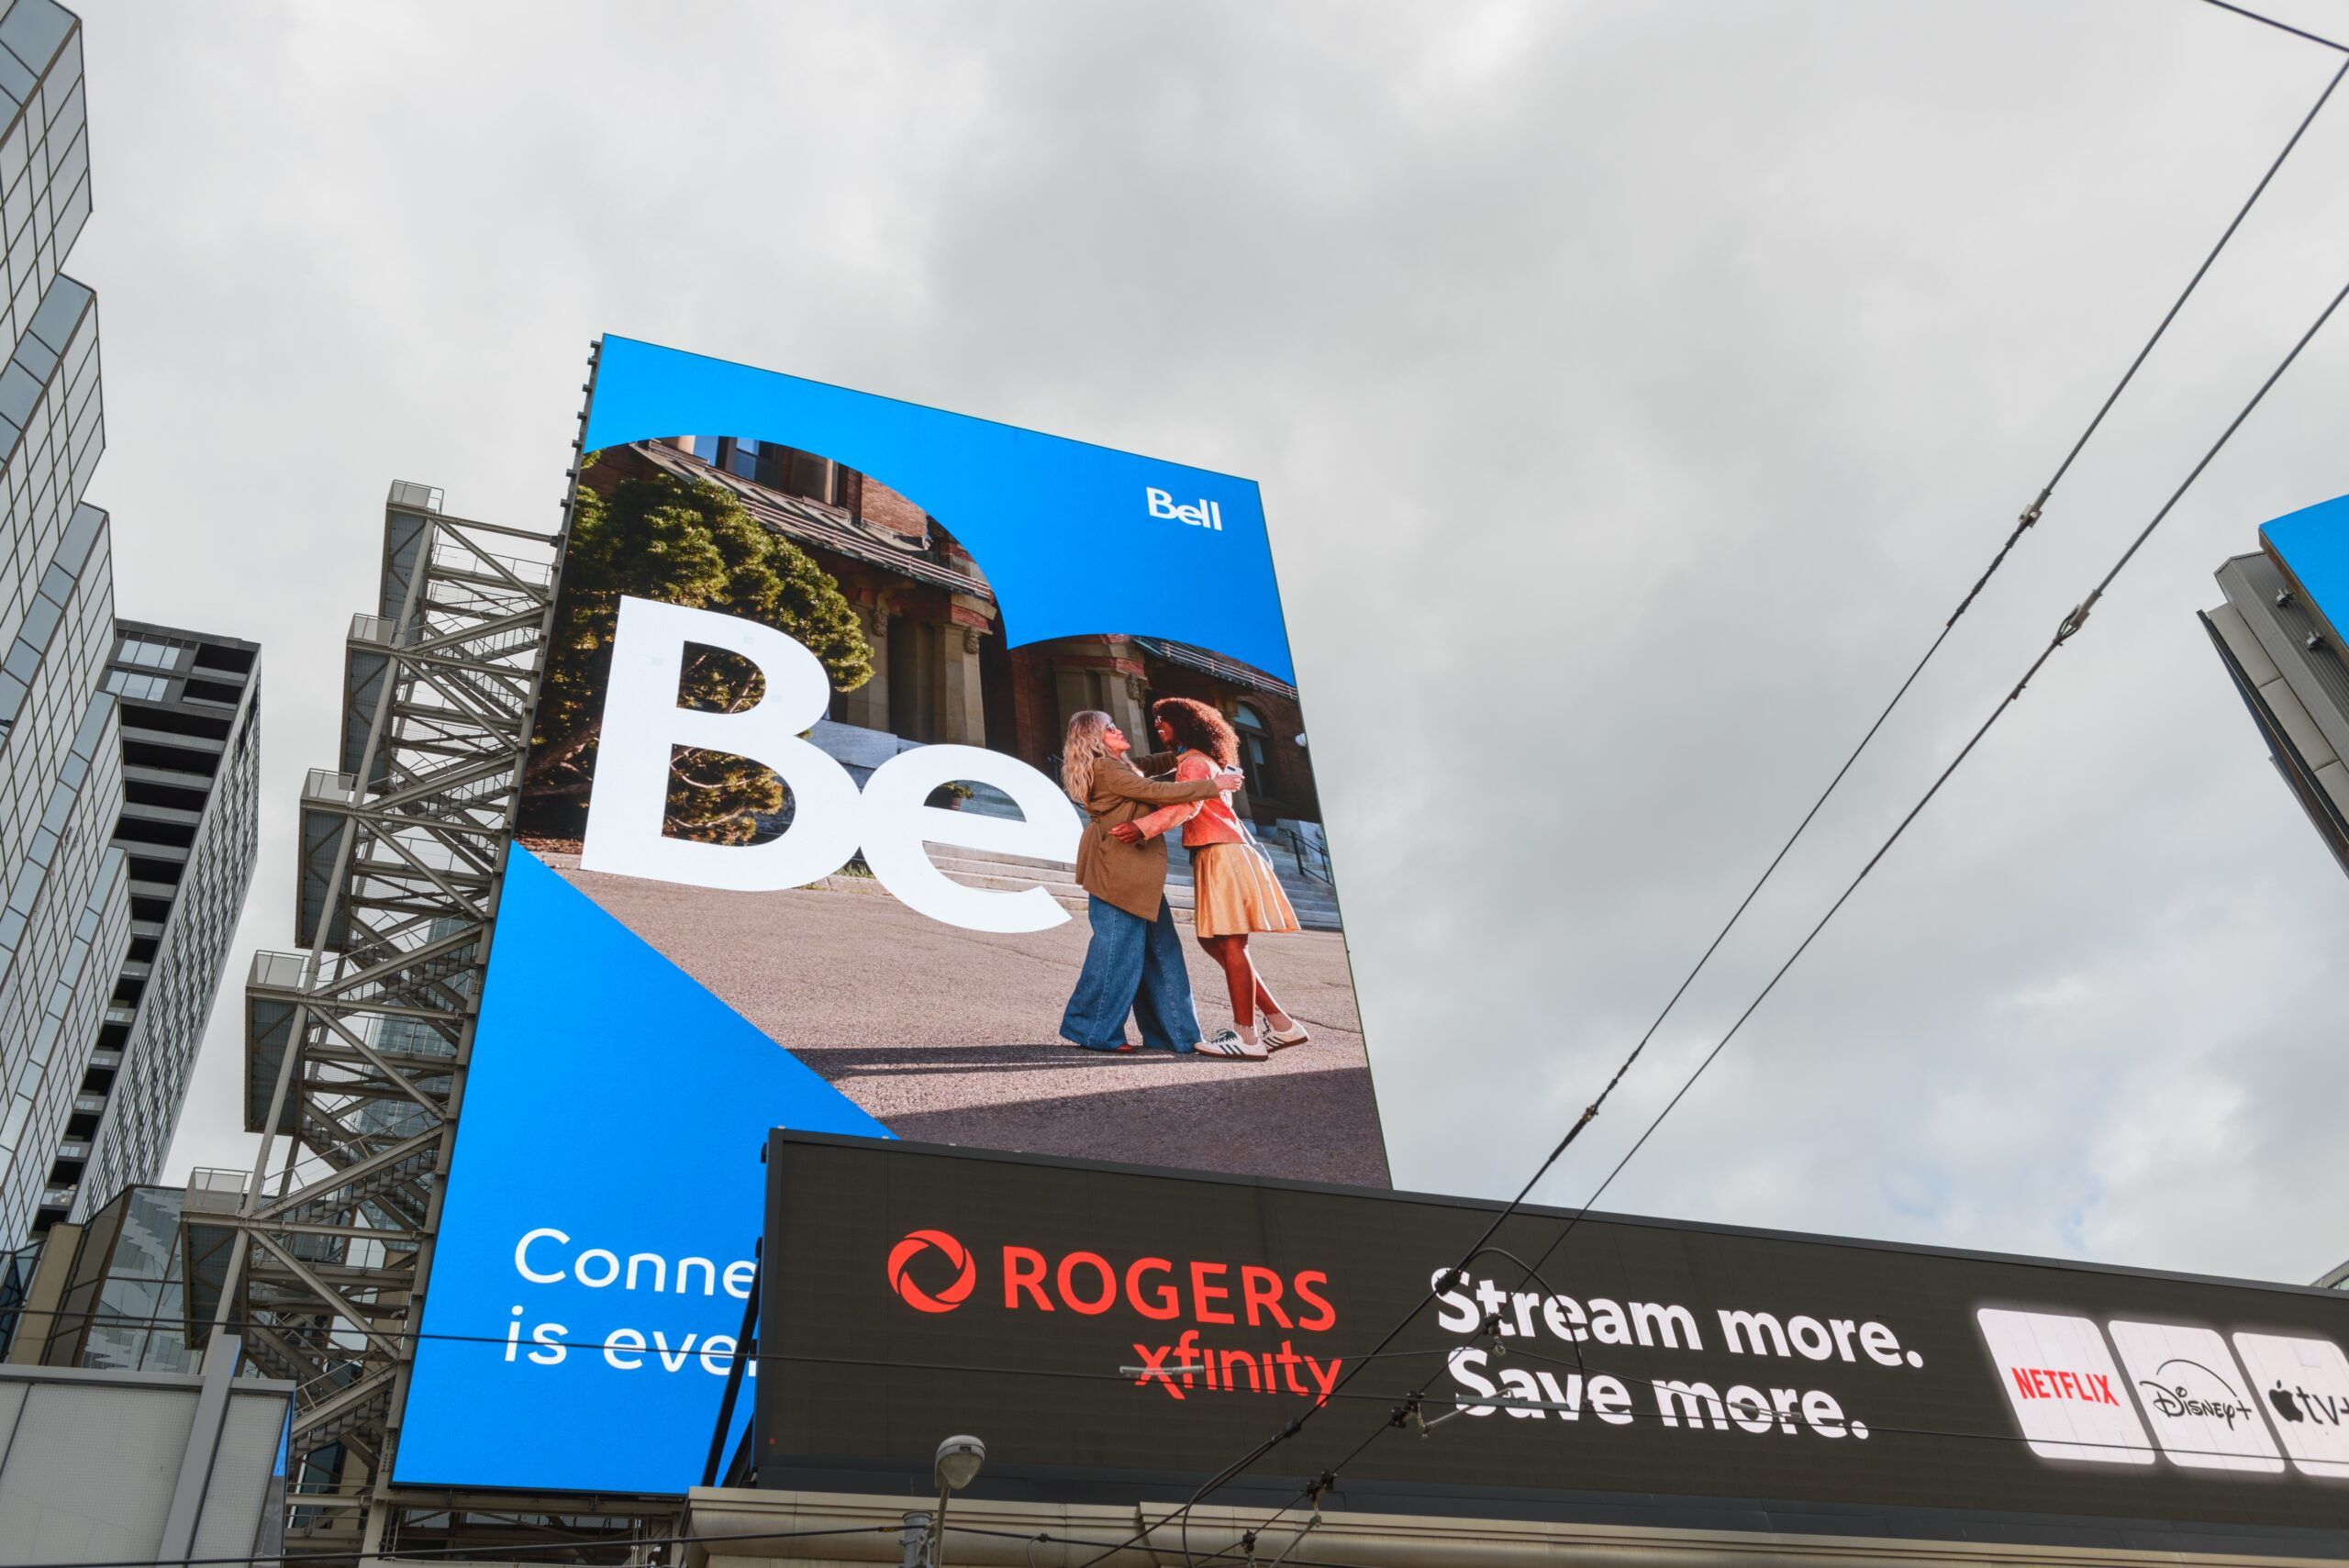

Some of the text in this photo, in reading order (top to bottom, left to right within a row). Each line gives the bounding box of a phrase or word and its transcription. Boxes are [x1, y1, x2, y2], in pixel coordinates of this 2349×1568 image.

[1145, 486, 1222, 530] Bell
[580, 595, 1084, 934] Be
[1002, 1245, 1336, 1332] ROGERS
[1431, 1266, 1923, 1369] Stream more.
[505, 1306, 568, 1365] is
[1132, 1329, 1342, 1407] xfinity
[1447, 1346, 1869, 1440] Save more.
[2010, 1366, 2121, 1407] NETFLIX
[2139, 1376, 2253, 1431] Disney+
